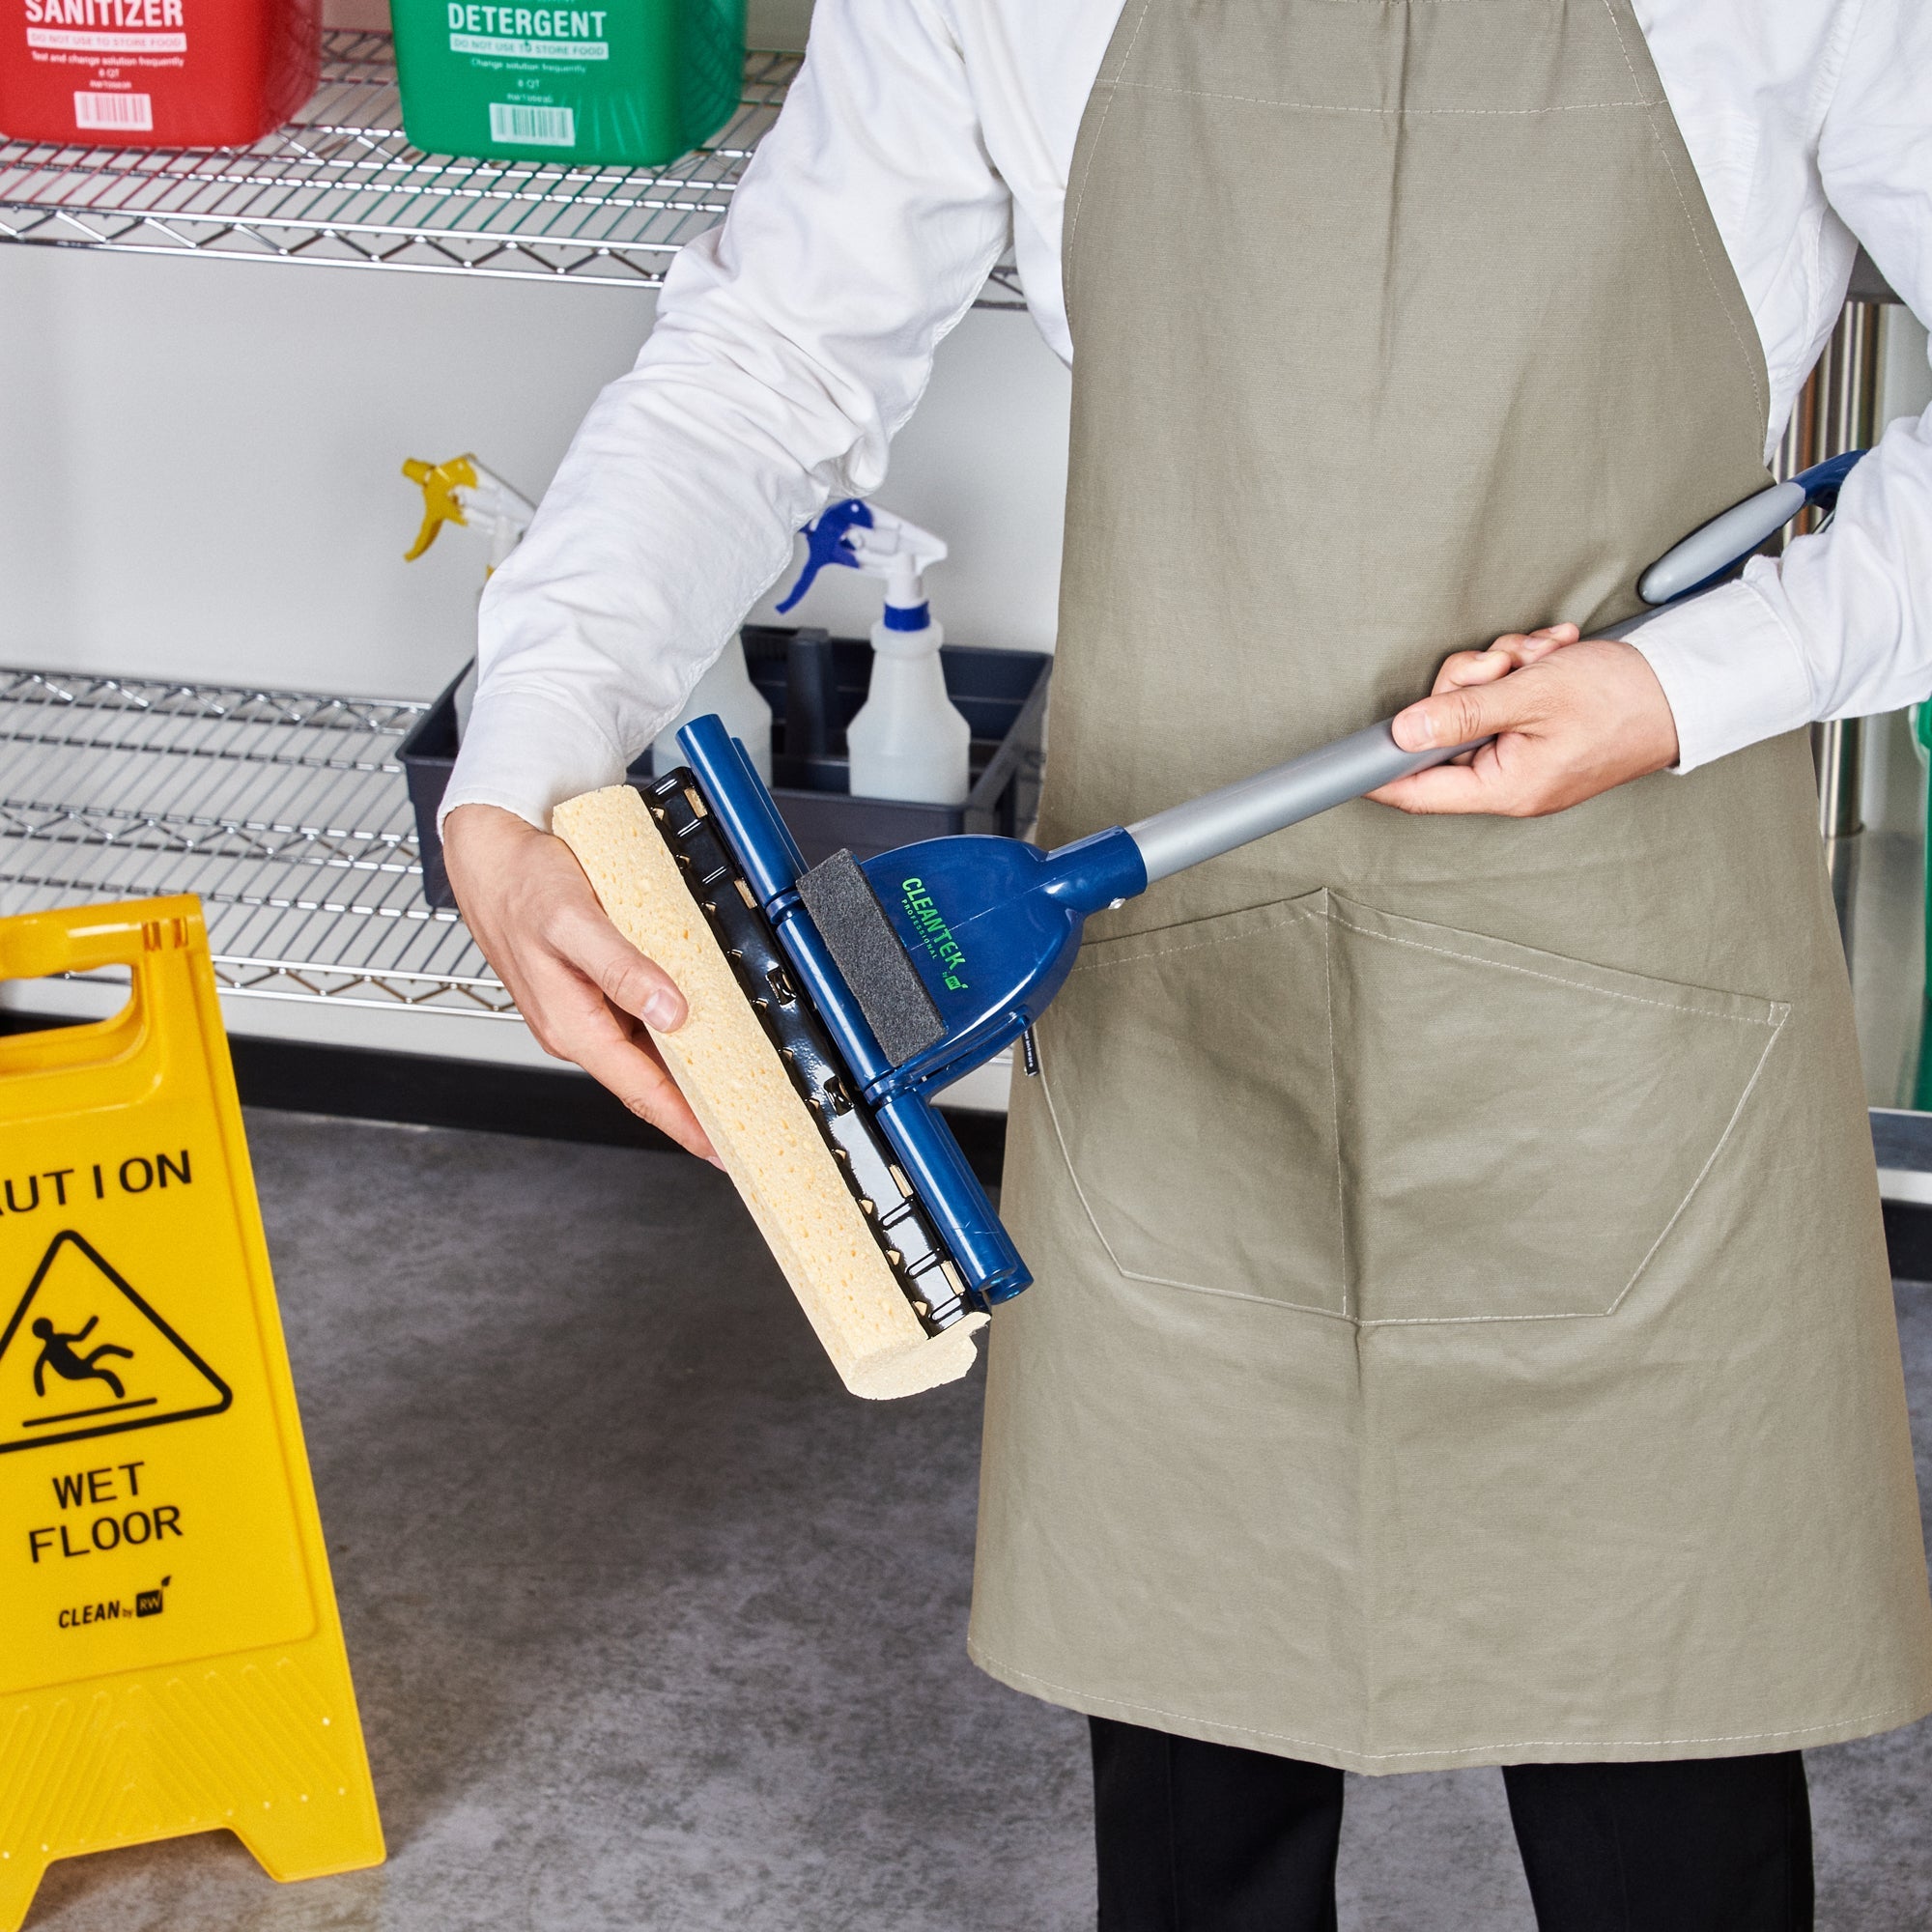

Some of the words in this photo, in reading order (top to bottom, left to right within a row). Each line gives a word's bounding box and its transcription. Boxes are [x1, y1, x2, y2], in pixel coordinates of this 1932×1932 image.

[25, 0, 184, 27] SANITIZER
[447, 2, 608, 38] DETERGENT
[31, 33, 45, 43] DO
[48, 35, 69, 44] NOT
[72, 37, 93, 46] USE
[96, 38, 110, 46] TO
[113, 39, 146, 47] STORE
[149, 39, 182, 48] FOOD
[454, 39, 469, 47] DO
[471, 40, 492, 49] NOT
[495, 42, 514, 51] USE
[519, 43, 532, 53] TO
[535, 44, 568, 54] STORE
[573, 45, 605, 56] FOOD
[49, 53, 67, 64] and
[68, 54, 100, 68] change
[101, 56, 137, 67] solution
[138, 55, 185, 68] frequently
[471, 58, 503, 71] Change
[505, 62, 538, 71] solution
[542, 63, 585, 73] frequently
[901, 897, 939, 960] PROFESSIONAL
[902, 877, 966, 971] CLEANTEK
[0, 1150, 192, 1215] UTION
[52, 1461, 145, 1510] WET
[29, 1505, 184, 1563] FLOOR
[58, 1600, 121, 1629] CLEAN
[122, 1607, 133, 1619] by
[138, 1593, 161, 1612] RW
